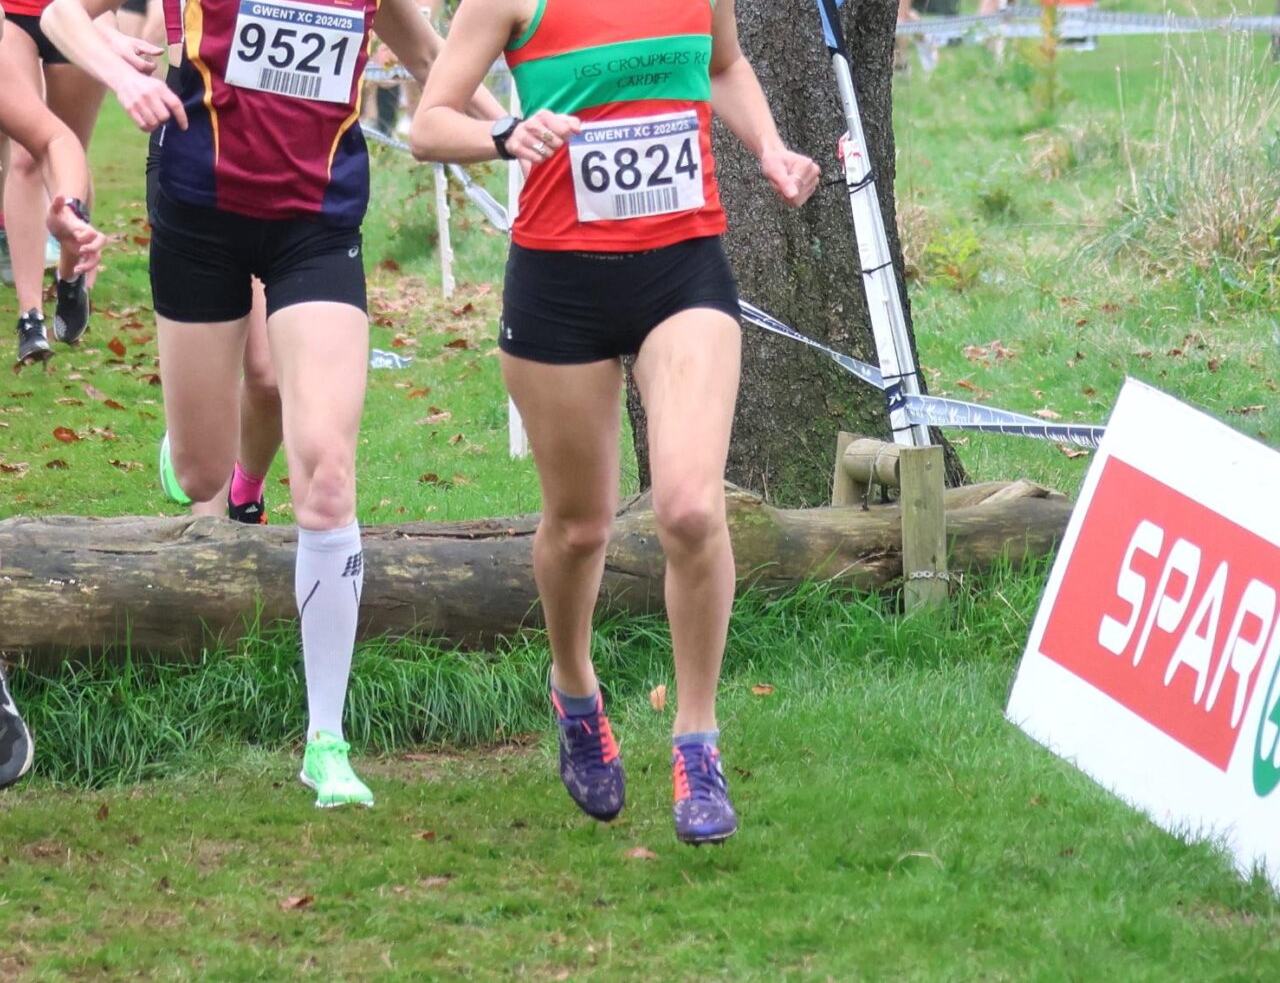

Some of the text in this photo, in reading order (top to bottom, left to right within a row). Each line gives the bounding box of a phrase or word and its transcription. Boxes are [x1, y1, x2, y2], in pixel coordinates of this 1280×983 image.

[252, 4, 353, 29] GWENT XC 2024/25
[237, 22, 349, 76] 9521
[574, 62, 602, 81] LES
[607, 50, 691, 73] CROUPIERS
[617, 71, 672, 89] CARDIFF
[584, 120, 690, 143] GWENT XC 2024/25
[580, 137, 699, 194] 6824
[1098, 519, 1277, 730] SPAR
